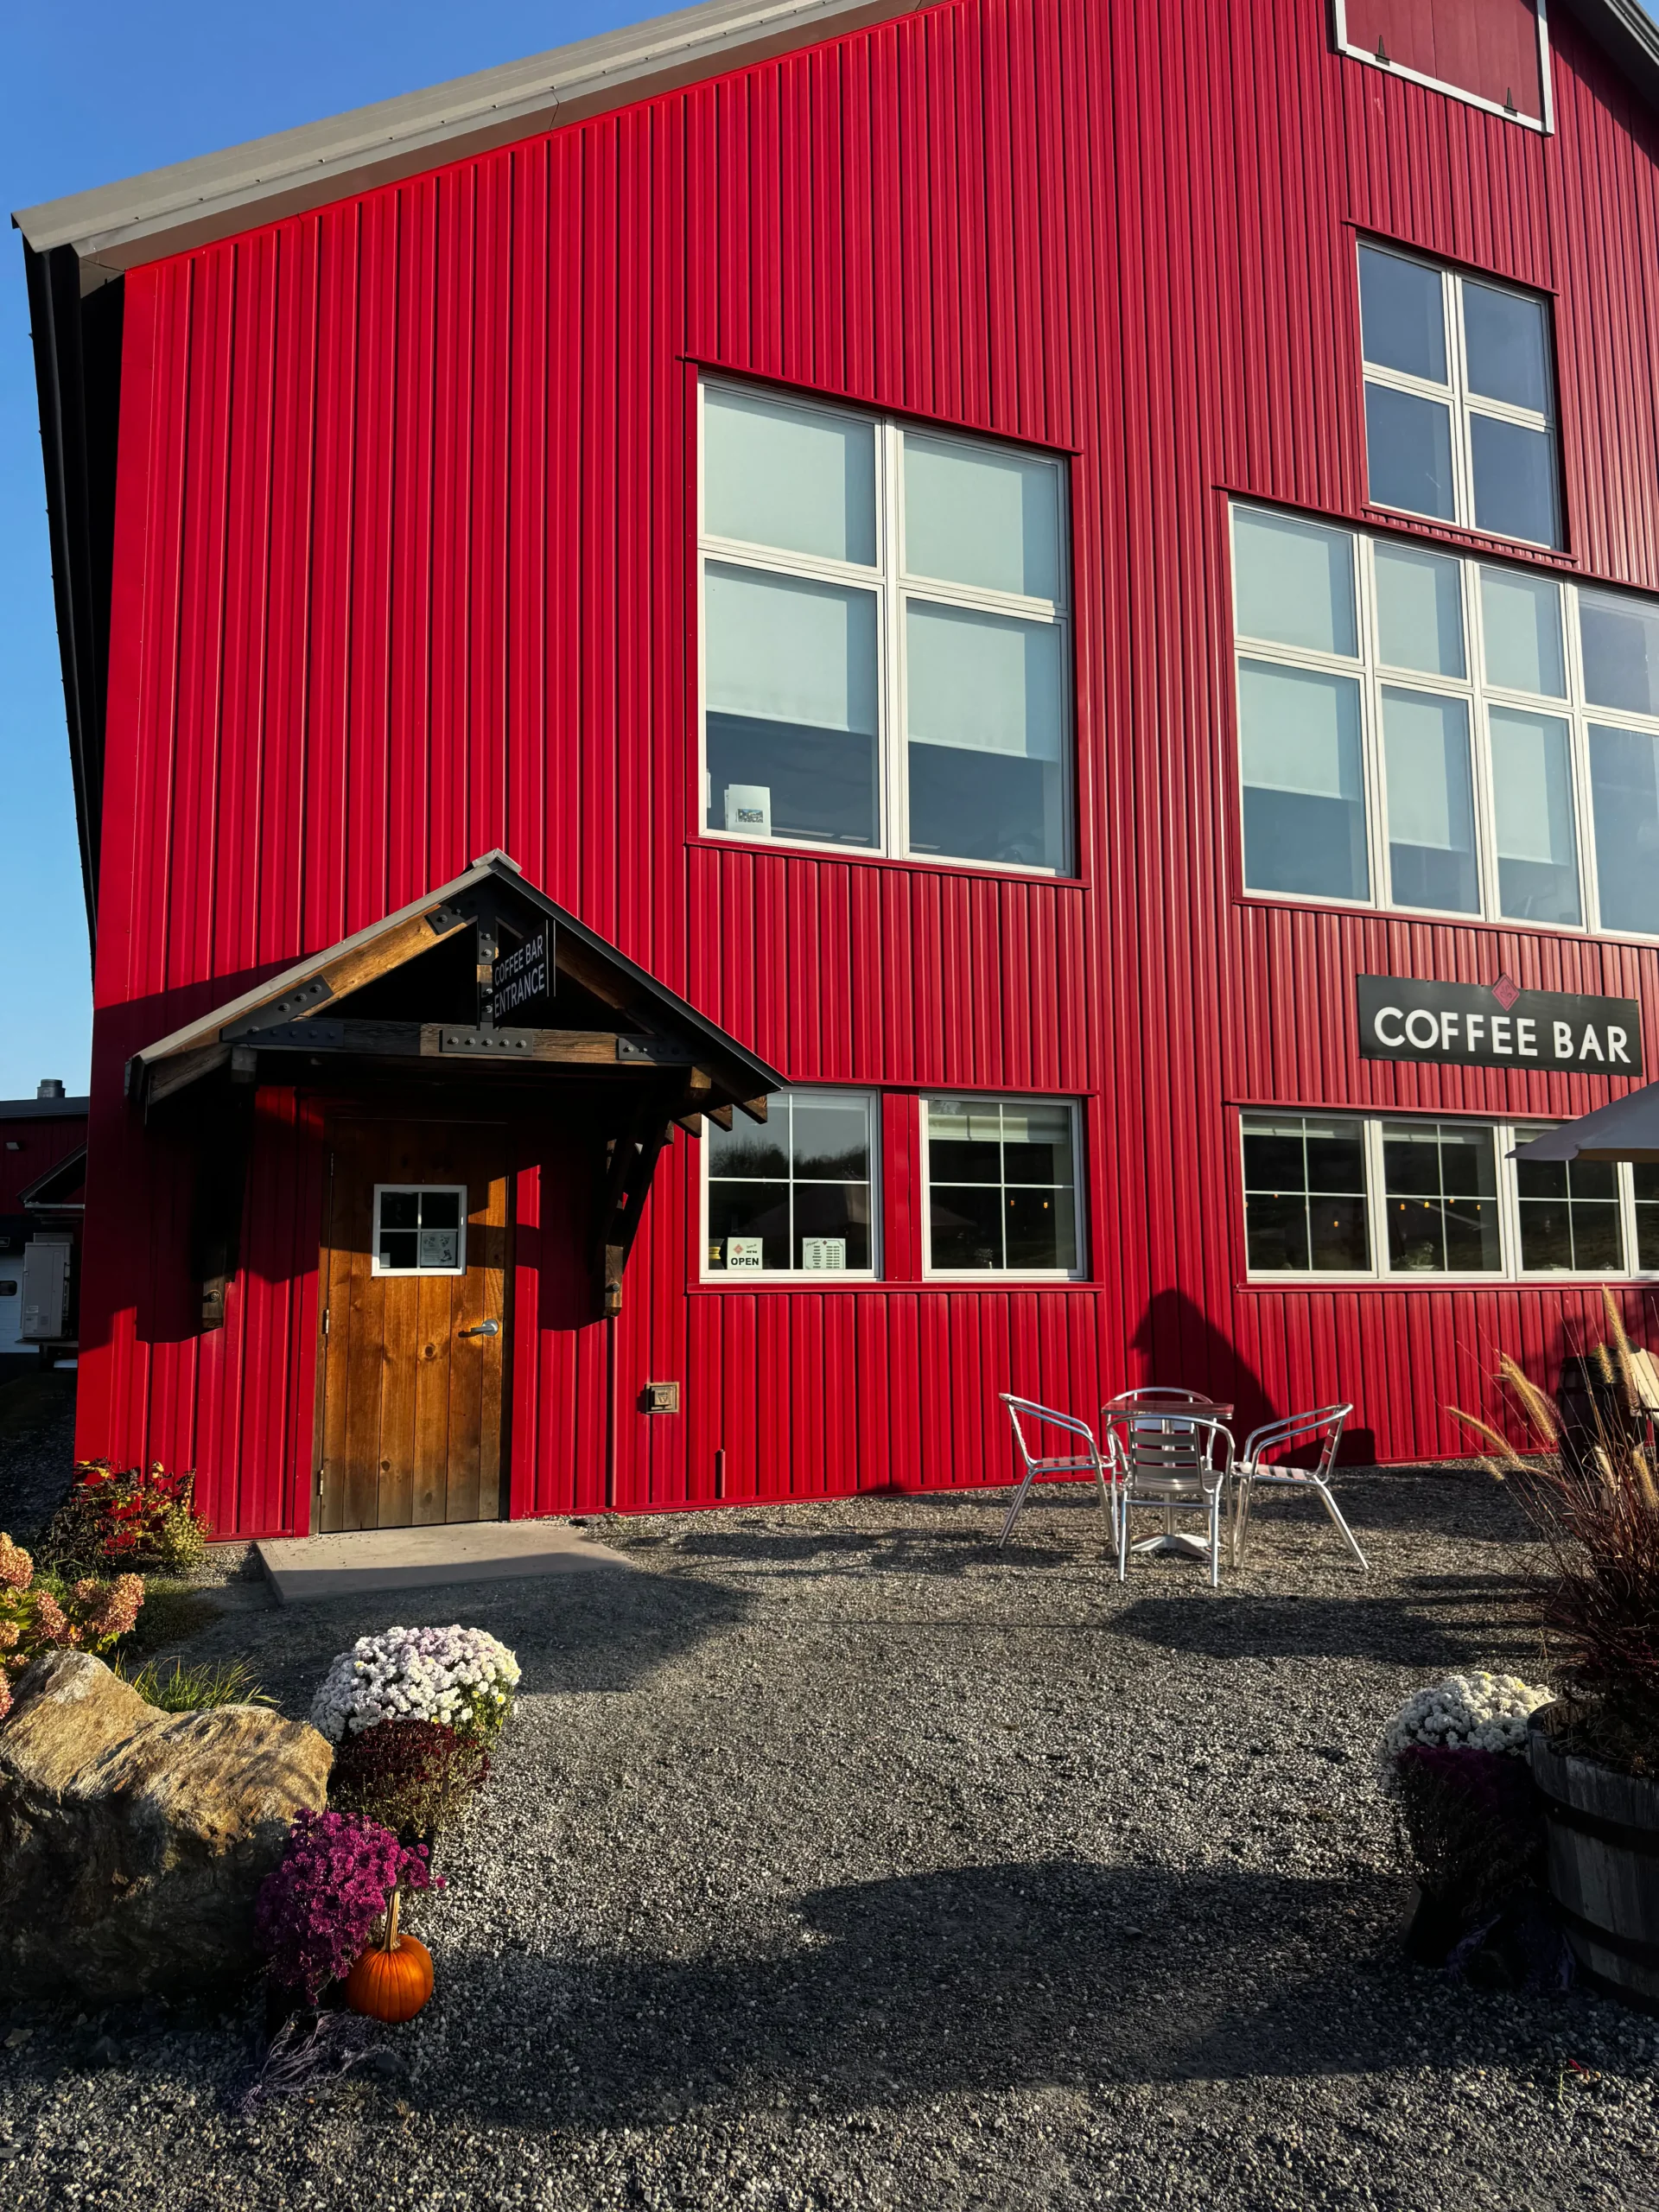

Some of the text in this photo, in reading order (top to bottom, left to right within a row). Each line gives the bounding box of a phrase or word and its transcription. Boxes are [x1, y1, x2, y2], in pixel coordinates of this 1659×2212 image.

[494, 934, 543, 987] COFFEE BAR
[494, 963, 545, 1019] ENTRANCE
[1374, 1006, 1631, 1064] COFFEE BAR
[731, 1257, 760, 1266] OPEN
